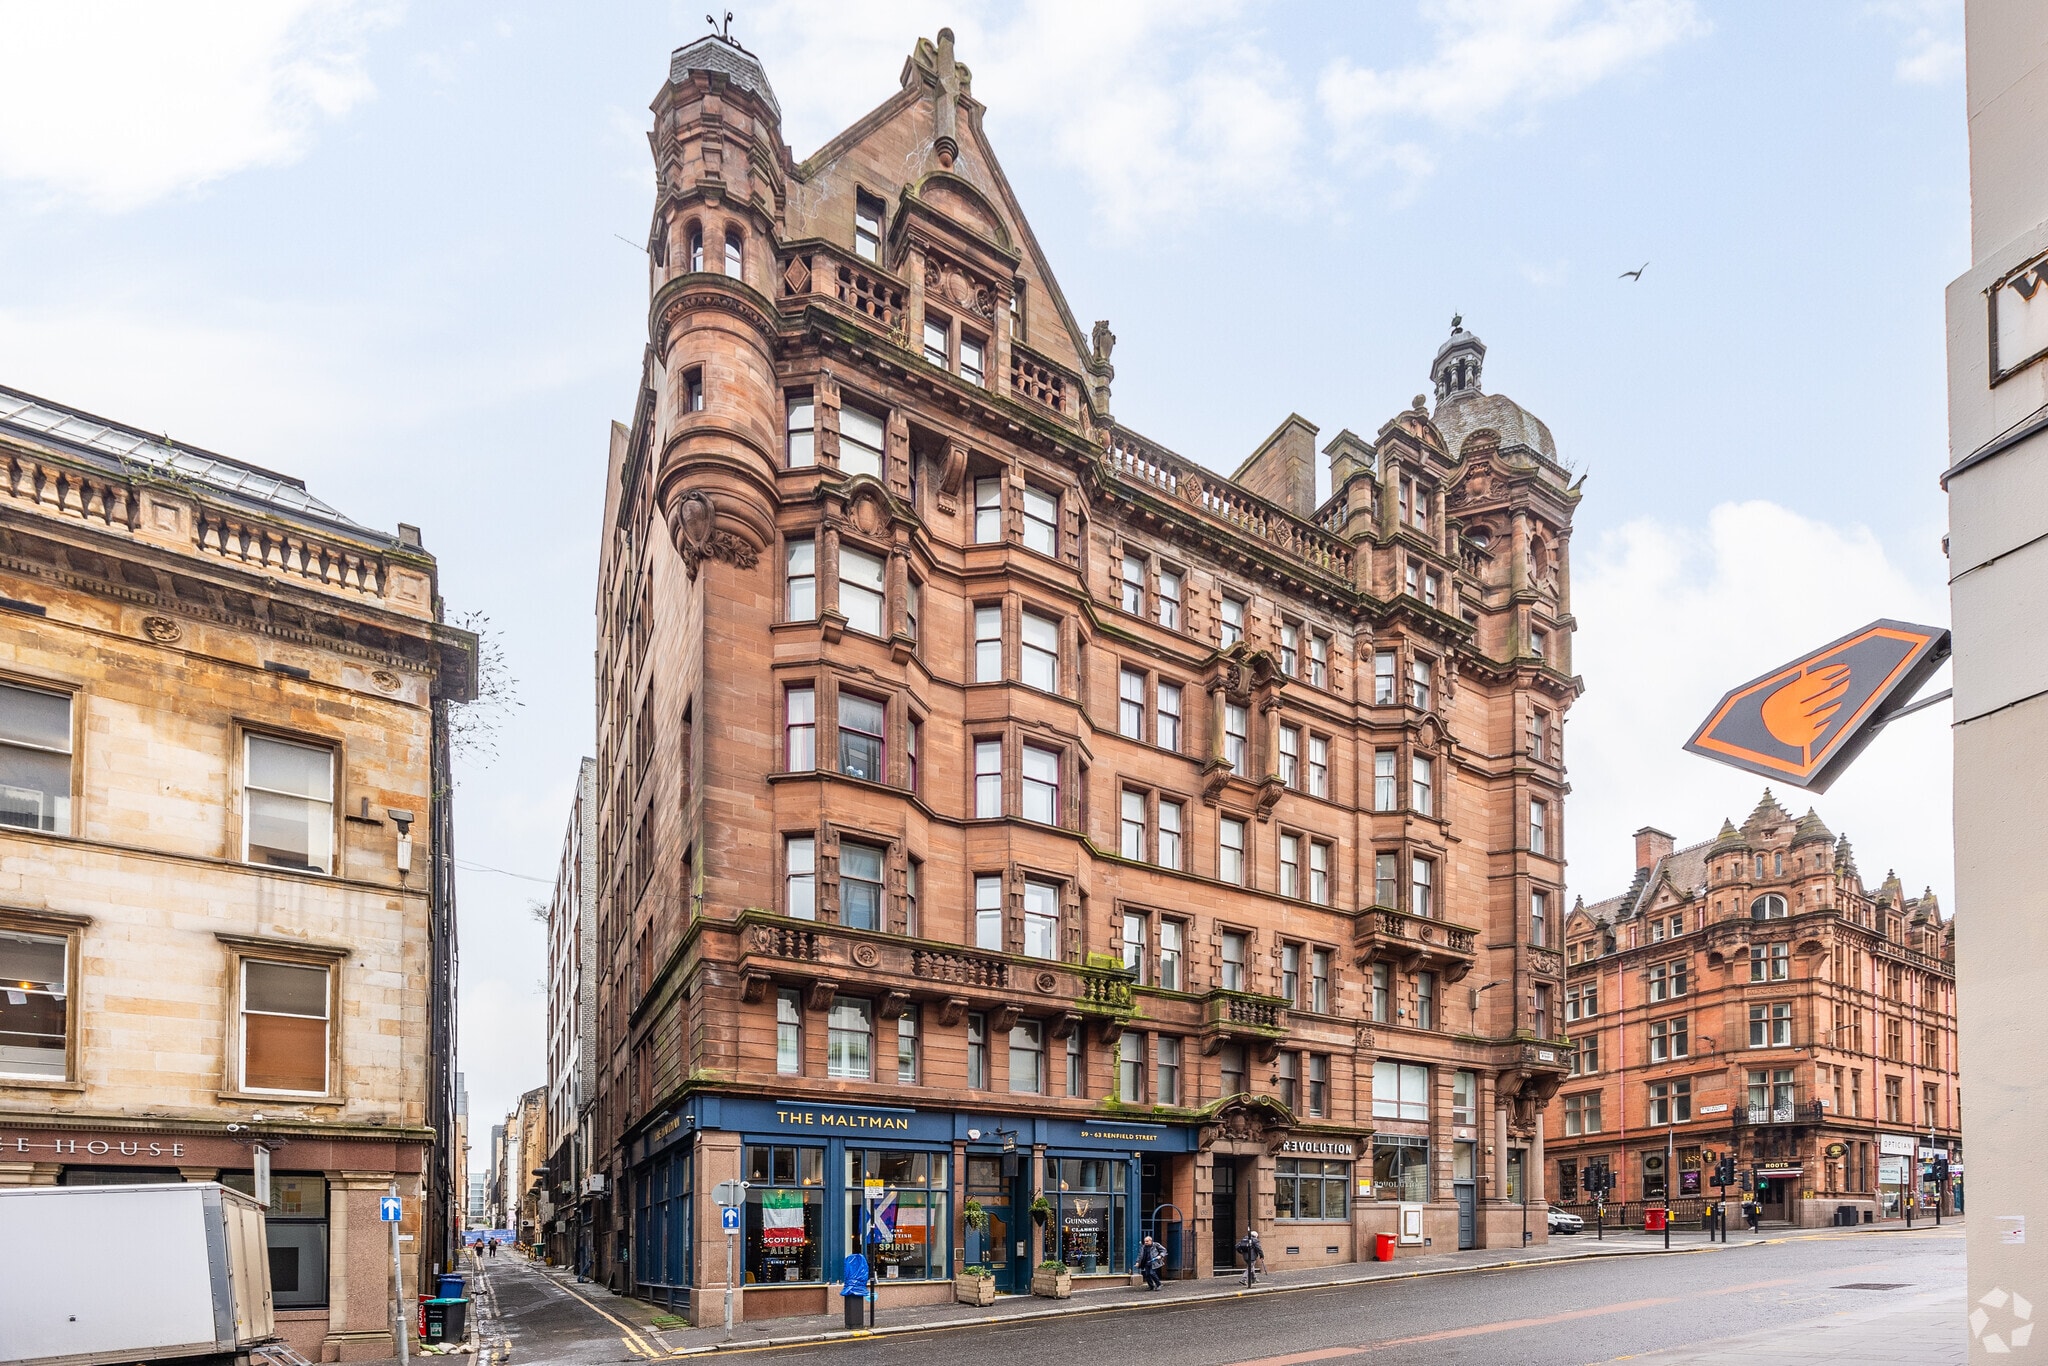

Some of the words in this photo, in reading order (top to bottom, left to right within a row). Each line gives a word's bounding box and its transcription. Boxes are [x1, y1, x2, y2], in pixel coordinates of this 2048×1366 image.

[776, 1111, 814, 1125] THE
[821, 1113, 908, 1130] MALTMAN
[1103, 1132, 1134, 1140] RENFIELD
[55, 1139, 185, 1157] HOUSE
[1884, 1140, 1912, 1149] OPTICIAN
[1064, 1216, 1098, 1225] GUINNESS
[770, 1246, 798, 1255] ALES
[879, 1243, 915, 1251] SPIRITS
